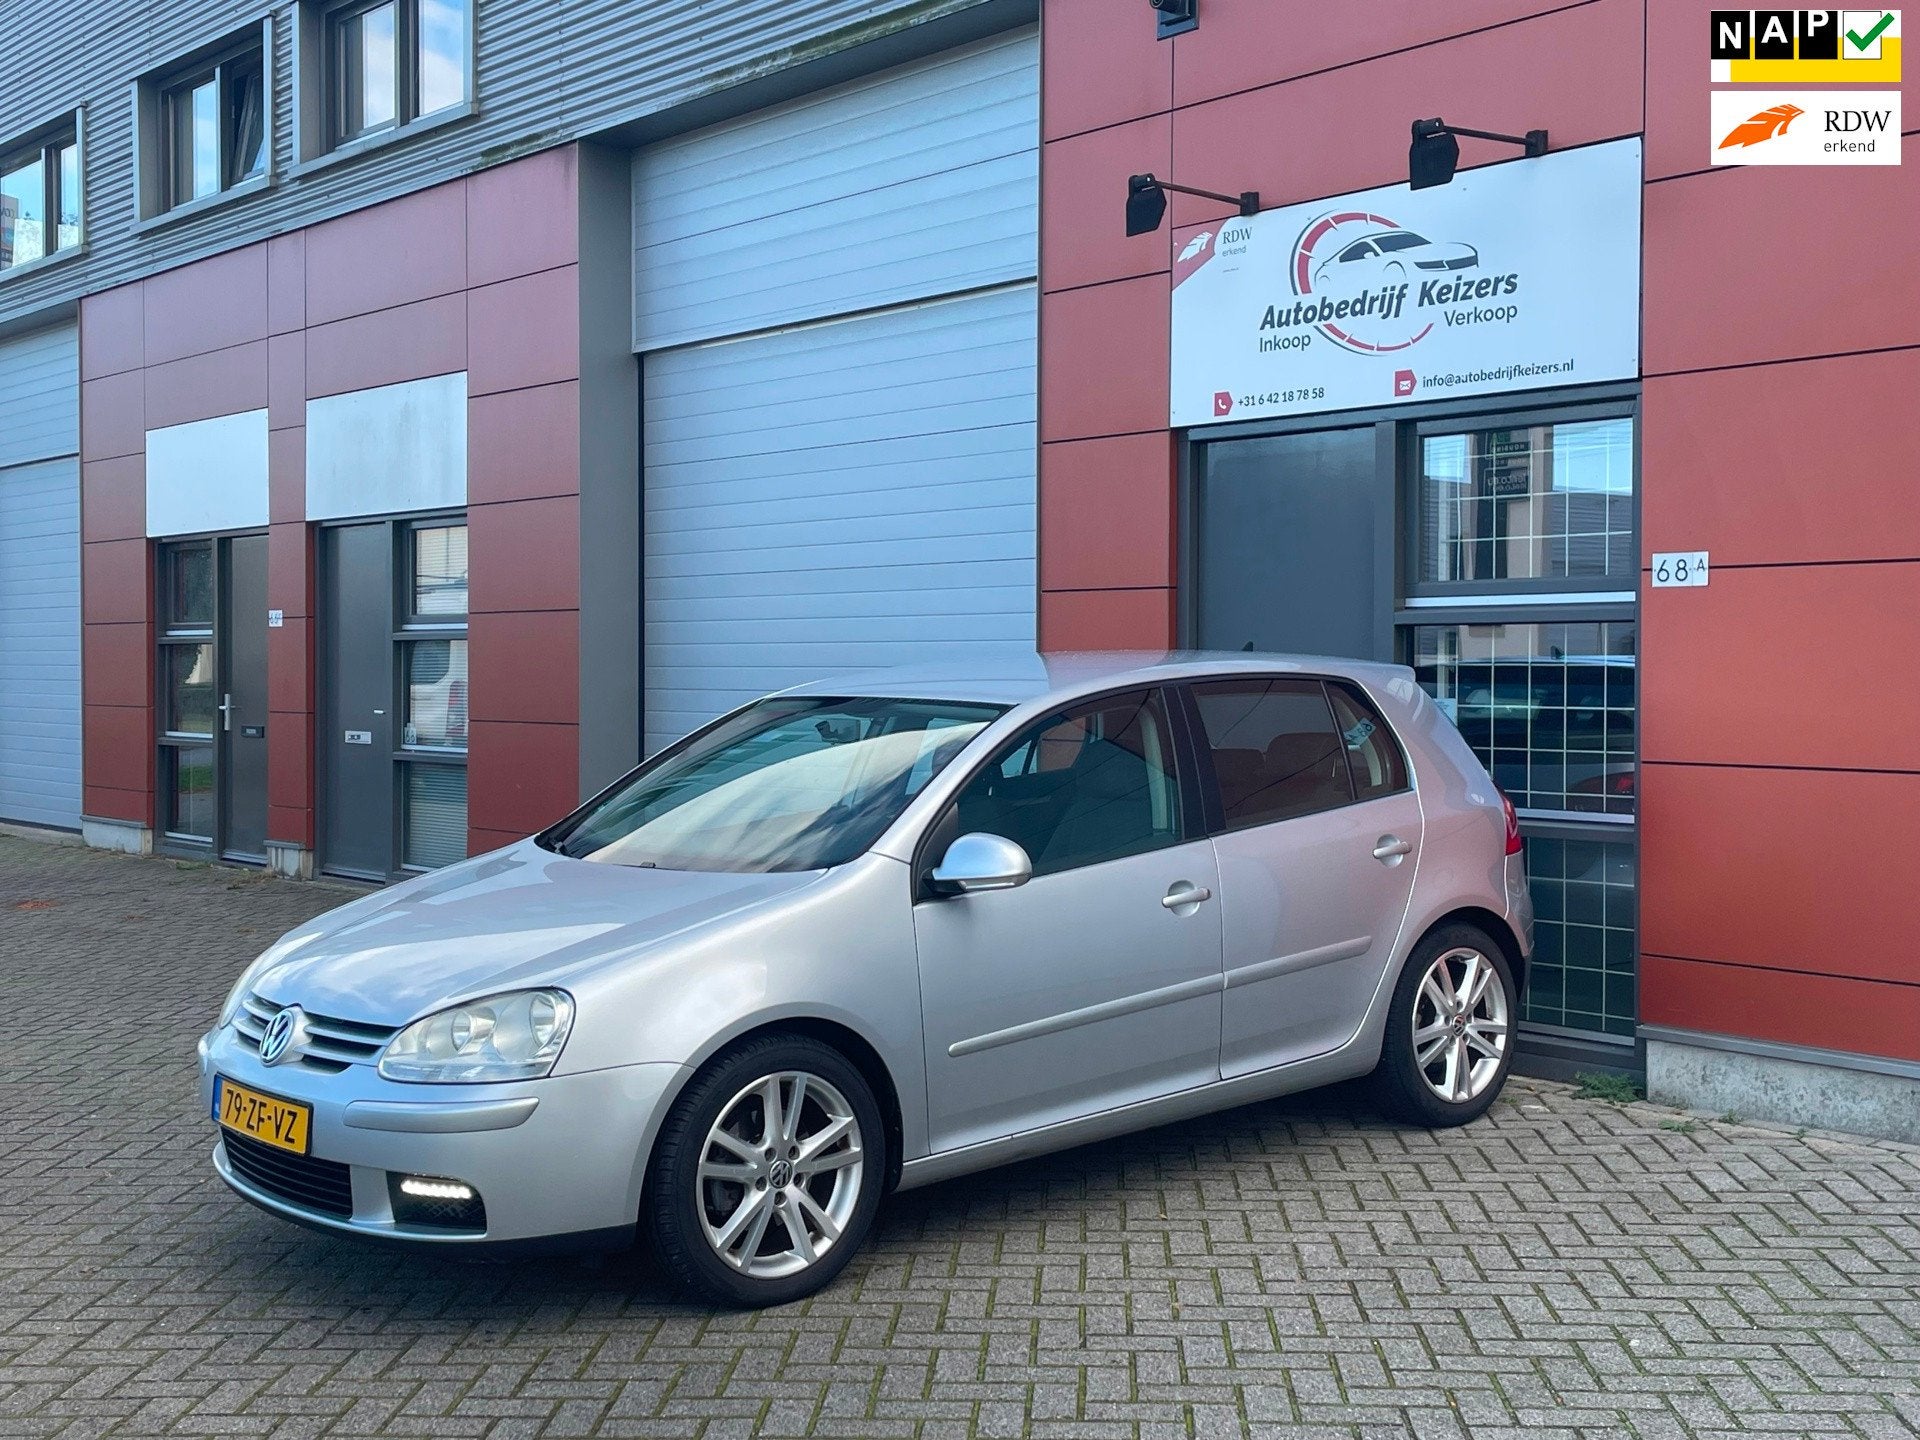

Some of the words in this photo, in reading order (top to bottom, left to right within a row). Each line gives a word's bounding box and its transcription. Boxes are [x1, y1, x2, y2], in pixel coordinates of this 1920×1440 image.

[1222, 227, 1252, 244] RDW
[1222, 245, 1247, 257] erkend
[1260, 283, 1409, 330] Autobedrijf
[1418, 273, 1519, 307] Keizers
[1444, 305, 1518, 327] Verkoop
[1260, 334, 1311, 353] Inkoop
[1422, 358, 1574, 388] info@autobedrijfkeizers.nl
[1238, 395, 1256, 406] +31
[1258, 394, 1265, 405] 6
[1267, 392, 1279, 404] 42
[1281, 390, 1295, 402] 18
[1296, 388, 1309, 400] 78
[1312, 387, 1325, 399] 58
[1657, 558, 1688, 582] 68
[1696, 558, 1706, 572] A
[225, 1088, 298, 1144] 79-ZF-VZ
